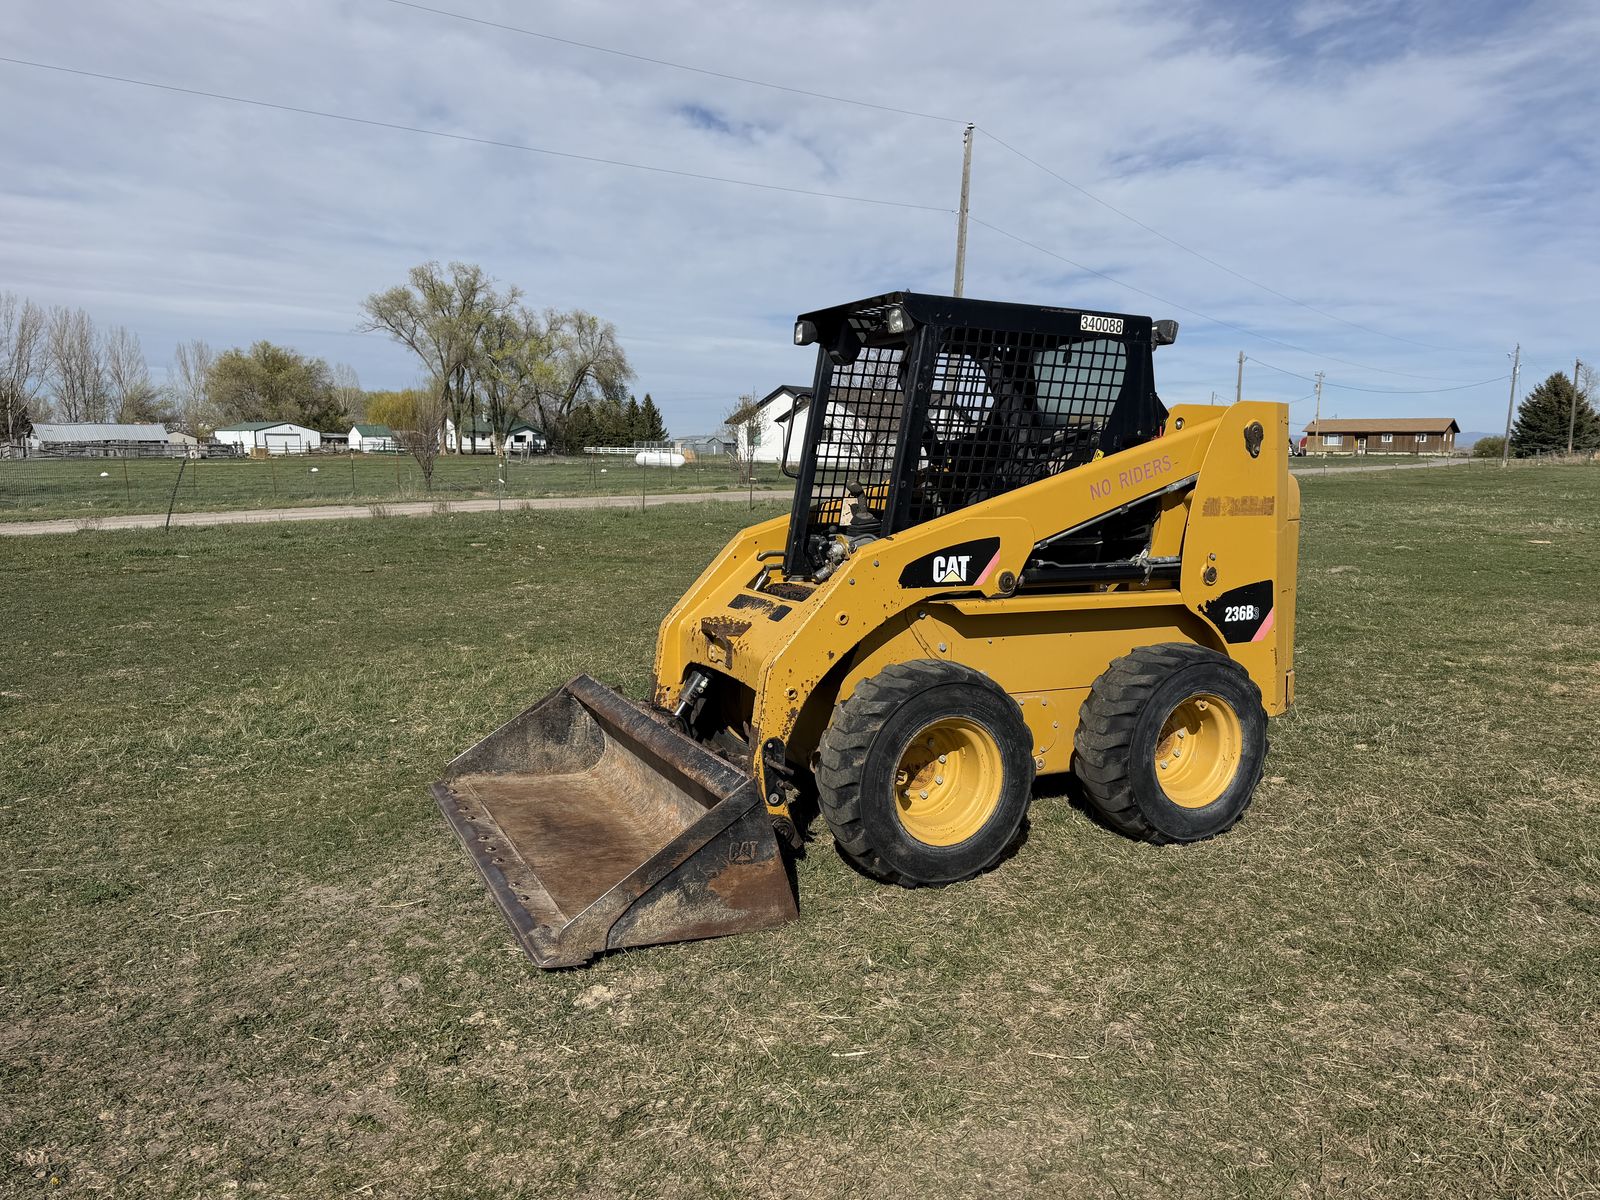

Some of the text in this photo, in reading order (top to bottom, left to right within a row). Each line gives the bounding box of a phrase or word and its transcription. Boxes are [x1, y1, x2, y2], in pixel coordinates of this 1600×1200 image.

[1081, 316, 1123, 333] 340088
[1090, 455, 1172, 500] NO RIDERS
[932, 555, 972, 583] CAT
[730, 841, 759, 862] CAT
